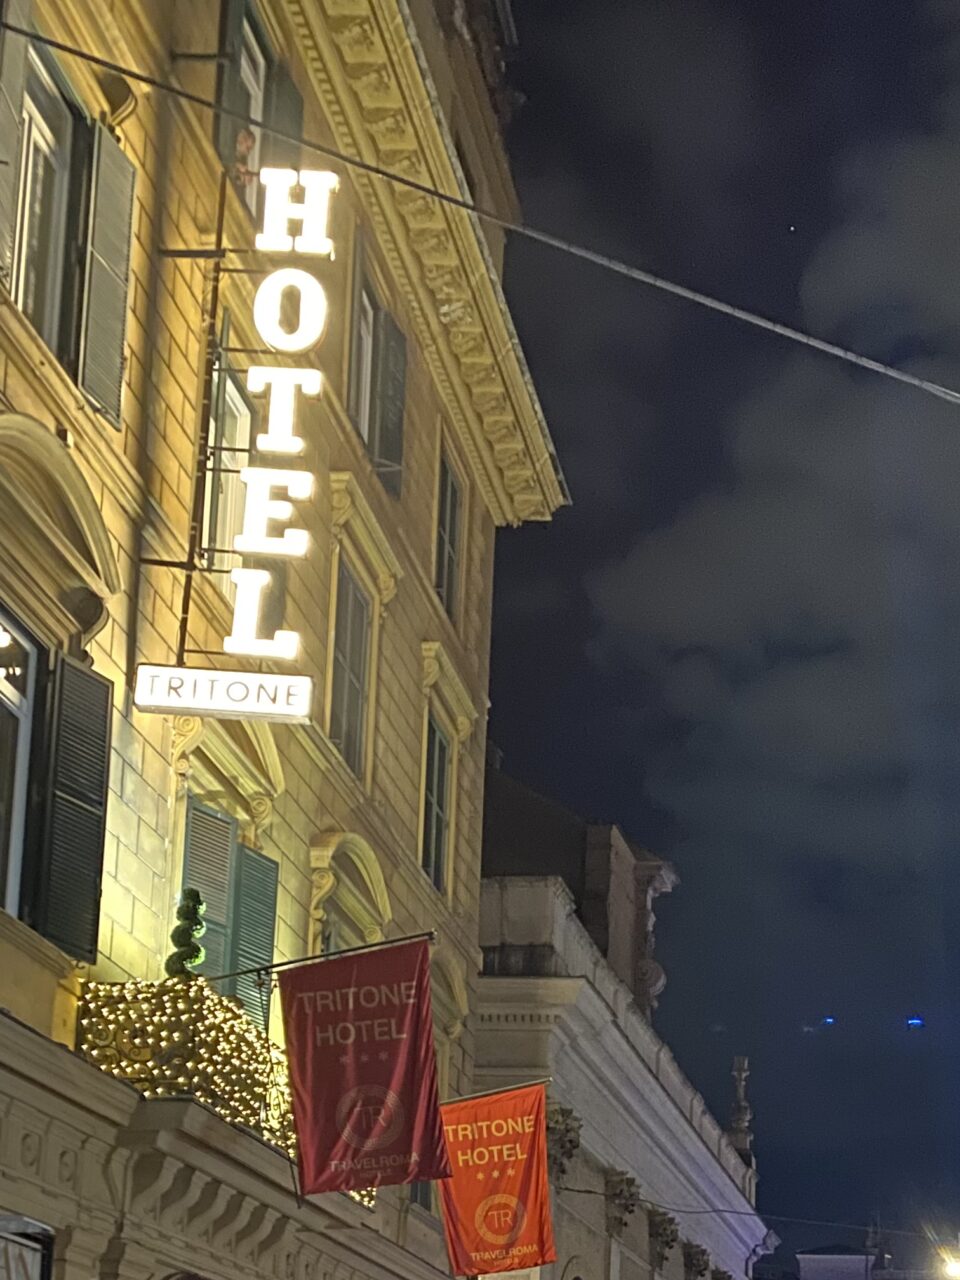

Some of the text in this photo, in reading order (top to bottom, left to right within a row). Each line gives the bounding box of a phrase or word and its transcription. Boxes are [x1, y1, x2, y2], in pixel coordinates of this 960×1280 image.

[223, 167, 338, 661] HOTEL
[150, 674, 299, 706] TRITONE
[297, 981, 418, 1014] TRITONE
[316, 1018, 407, 1047] HOTEL
[443, 1115, 535, 1143] TRITONE
[329, 1151, 420, 1172] TRAVELROMA
[457, 1143, 528, 1167] HOTEL
[487, 1209, 513, 1229] TR
[470, 1243, 539, 1262] TRAVELROMA
